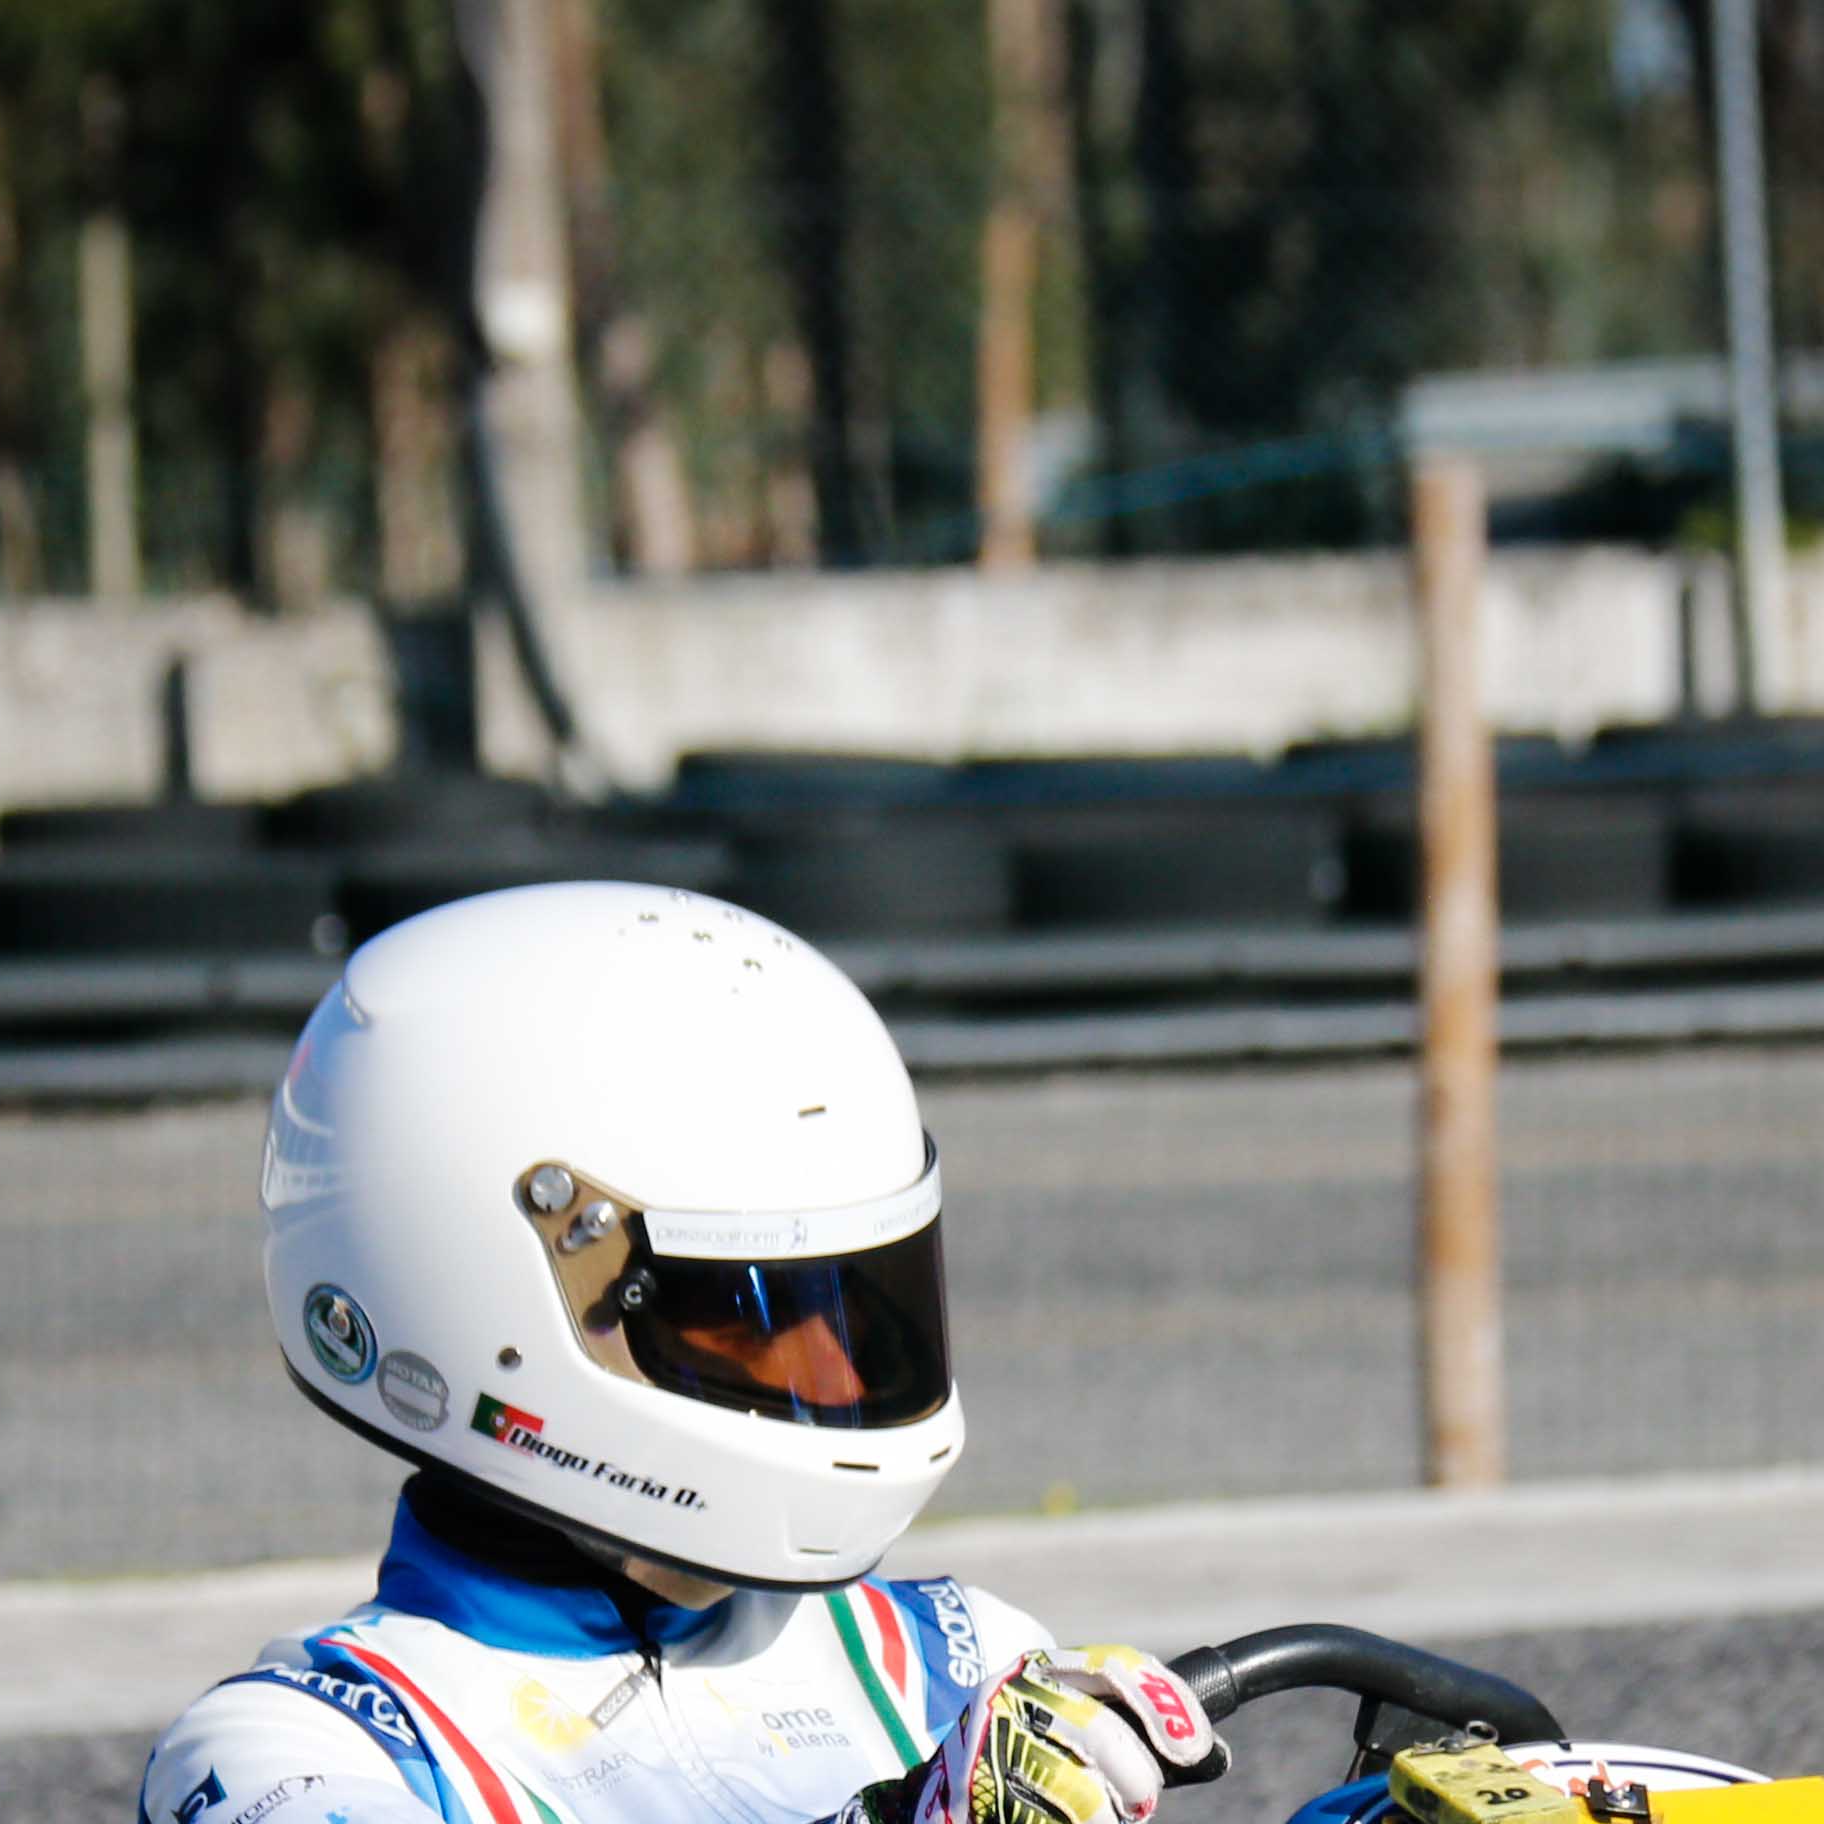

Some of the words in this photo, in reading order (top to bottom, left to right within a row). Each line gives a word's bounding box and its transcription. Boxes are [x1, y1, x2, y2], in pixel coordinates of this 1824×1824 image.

[509, 1427, 589, 1474] Diogo
[592, 1458, 668, 1501] Faria
[1477, 1787, 1532, 1806] 20
